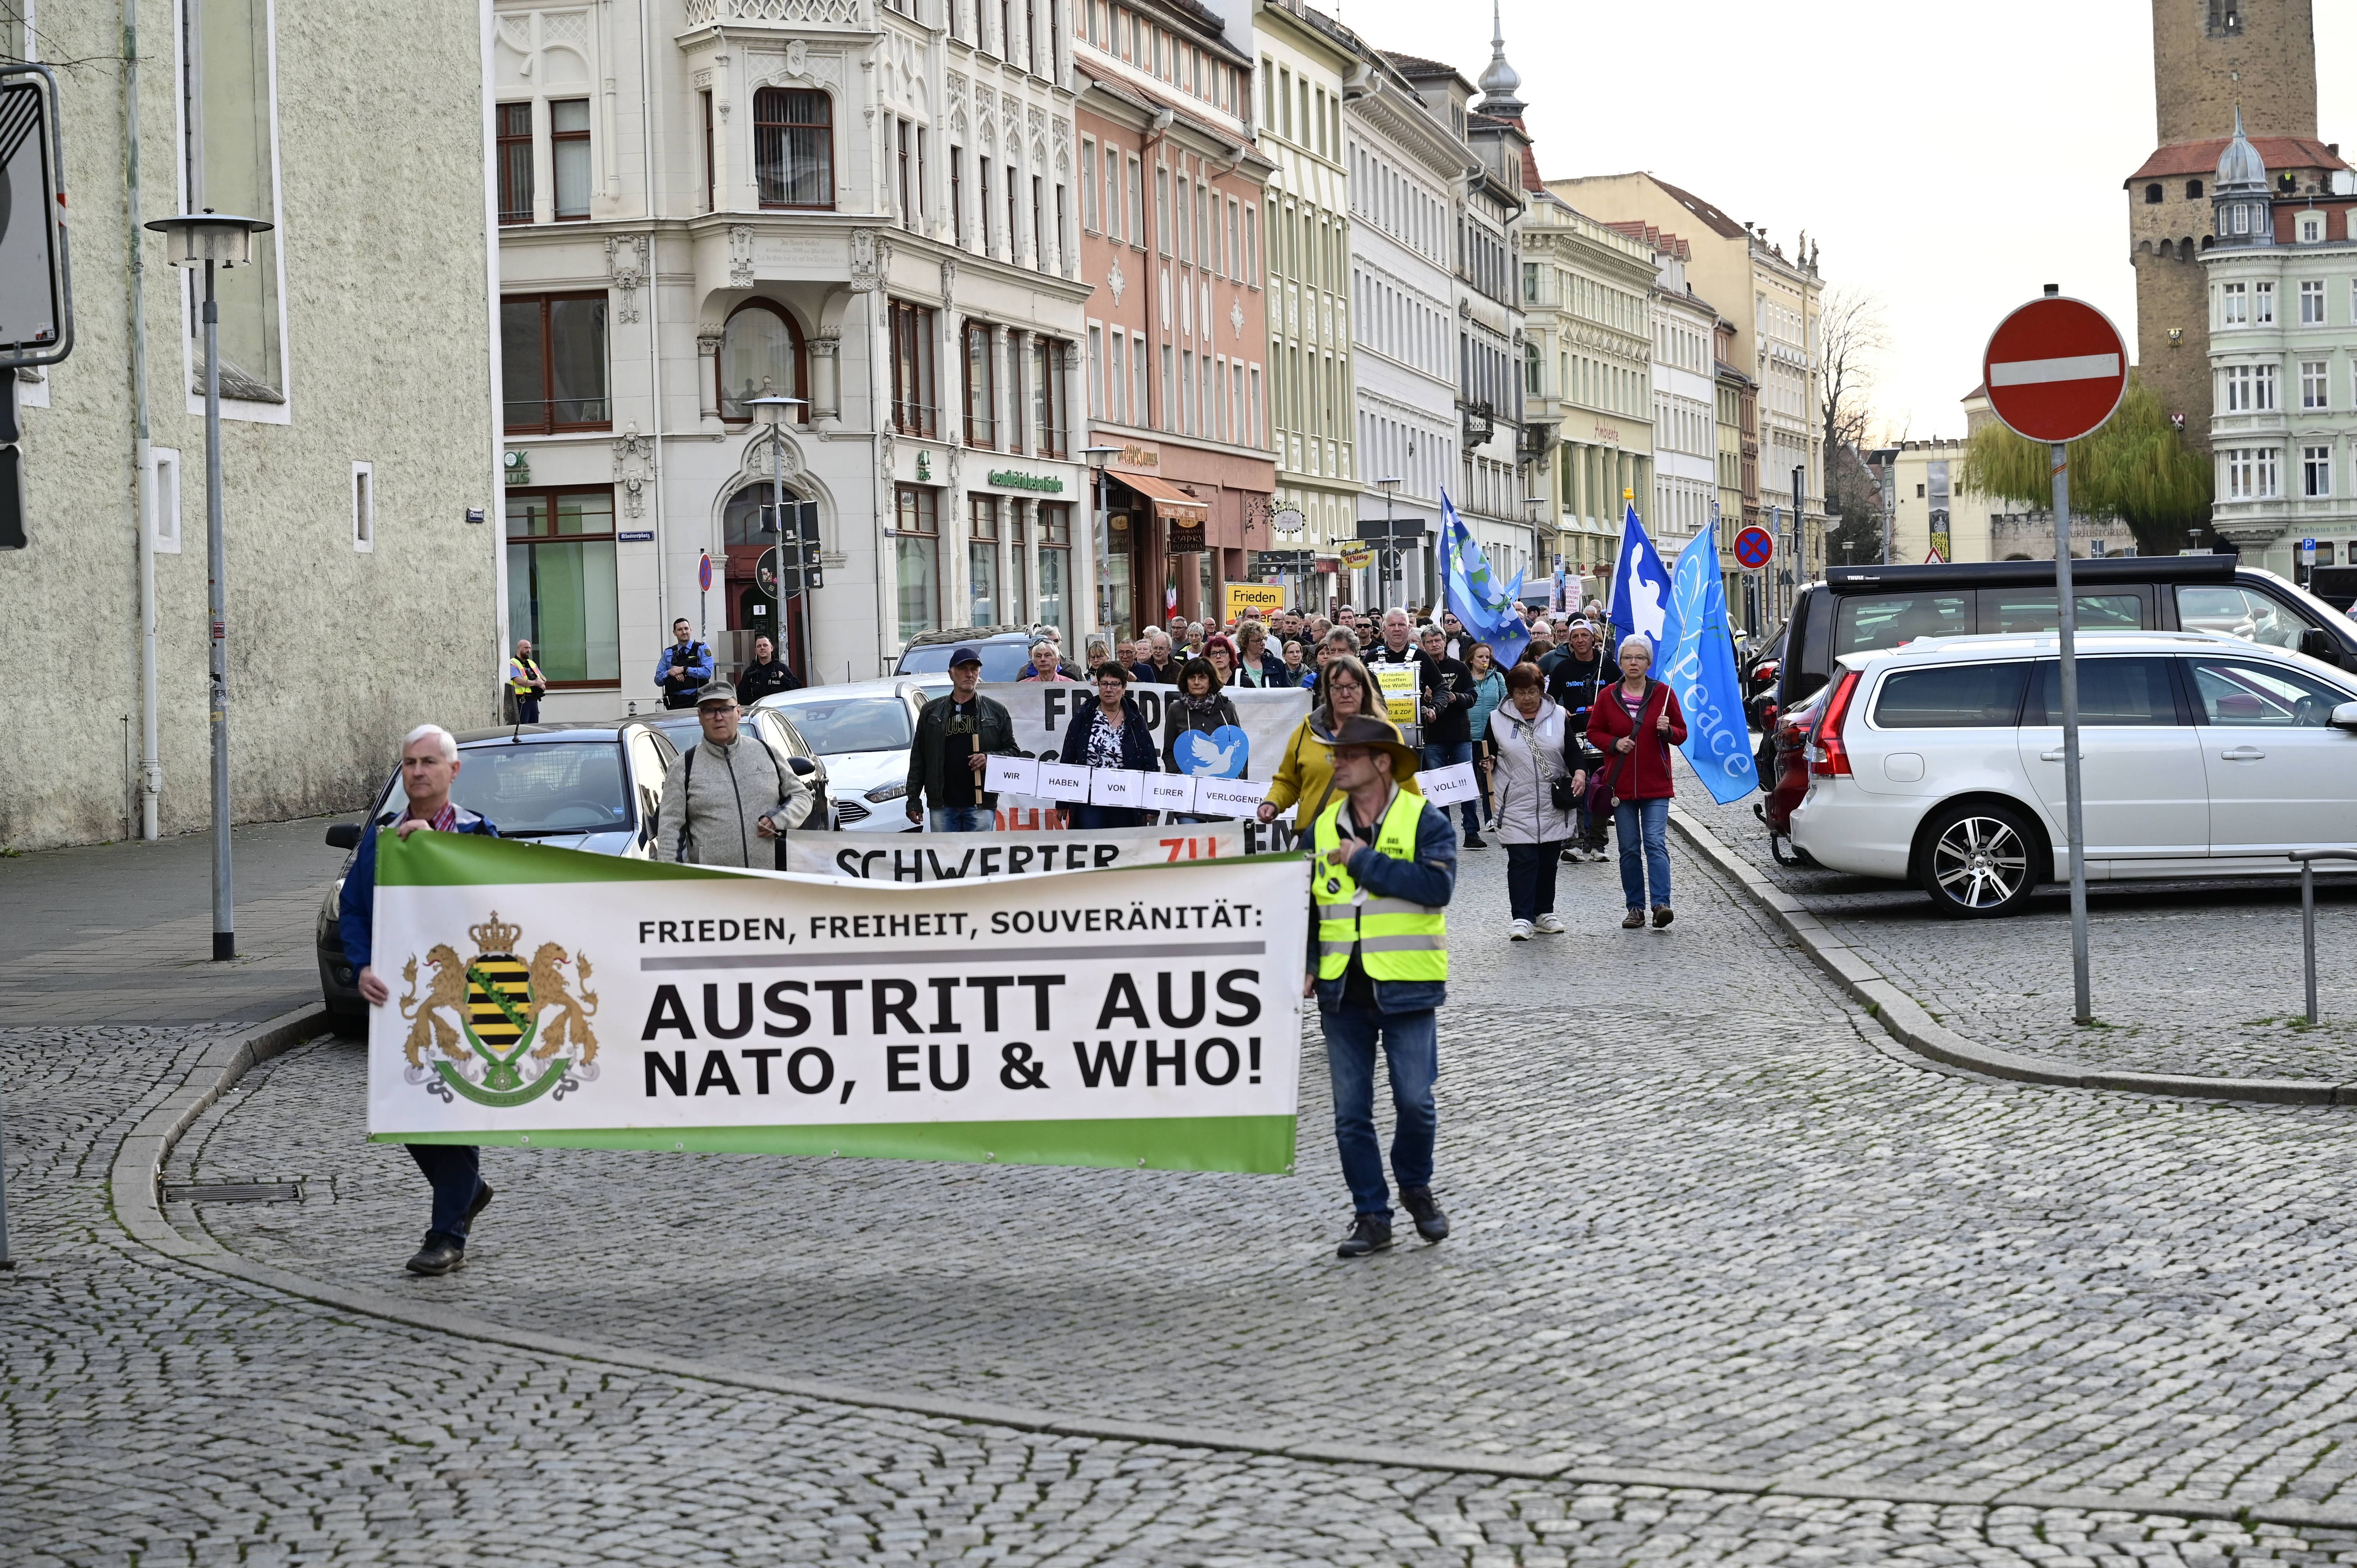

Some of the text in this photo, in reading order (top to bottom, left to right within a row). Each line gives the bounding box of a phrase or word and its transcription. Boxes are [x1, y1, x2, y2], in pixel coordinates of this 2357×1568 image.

[1595, 417, 1618, 442] Ambiente
[988, 469, 1022, 488] Gesundheit
[1026, 472, 1045, 491] besten
[1044, 476, 1063, 492] Händen
[1345, 554, 1369, 564] Wittig
[1234, 590, 1276, 603] Frieden
[1004, 771, 1020, 780] WIR
[1049, 778, 1079, 787] HABEN
[1154, 788, 1183, 797] EURER
[1434, 781, 1457, 791] VOLL
[836, 844, 1120, 883] SCHWERTER
[639, 899, 1262, 945] FRIEDEN, FREIHEIT, SOUVERÄNITÄT:
[641, 969, 1262, 1040] AUSTRITT AUS
[645, 1037, 1262, 1105] NATO, EU & WHO!
